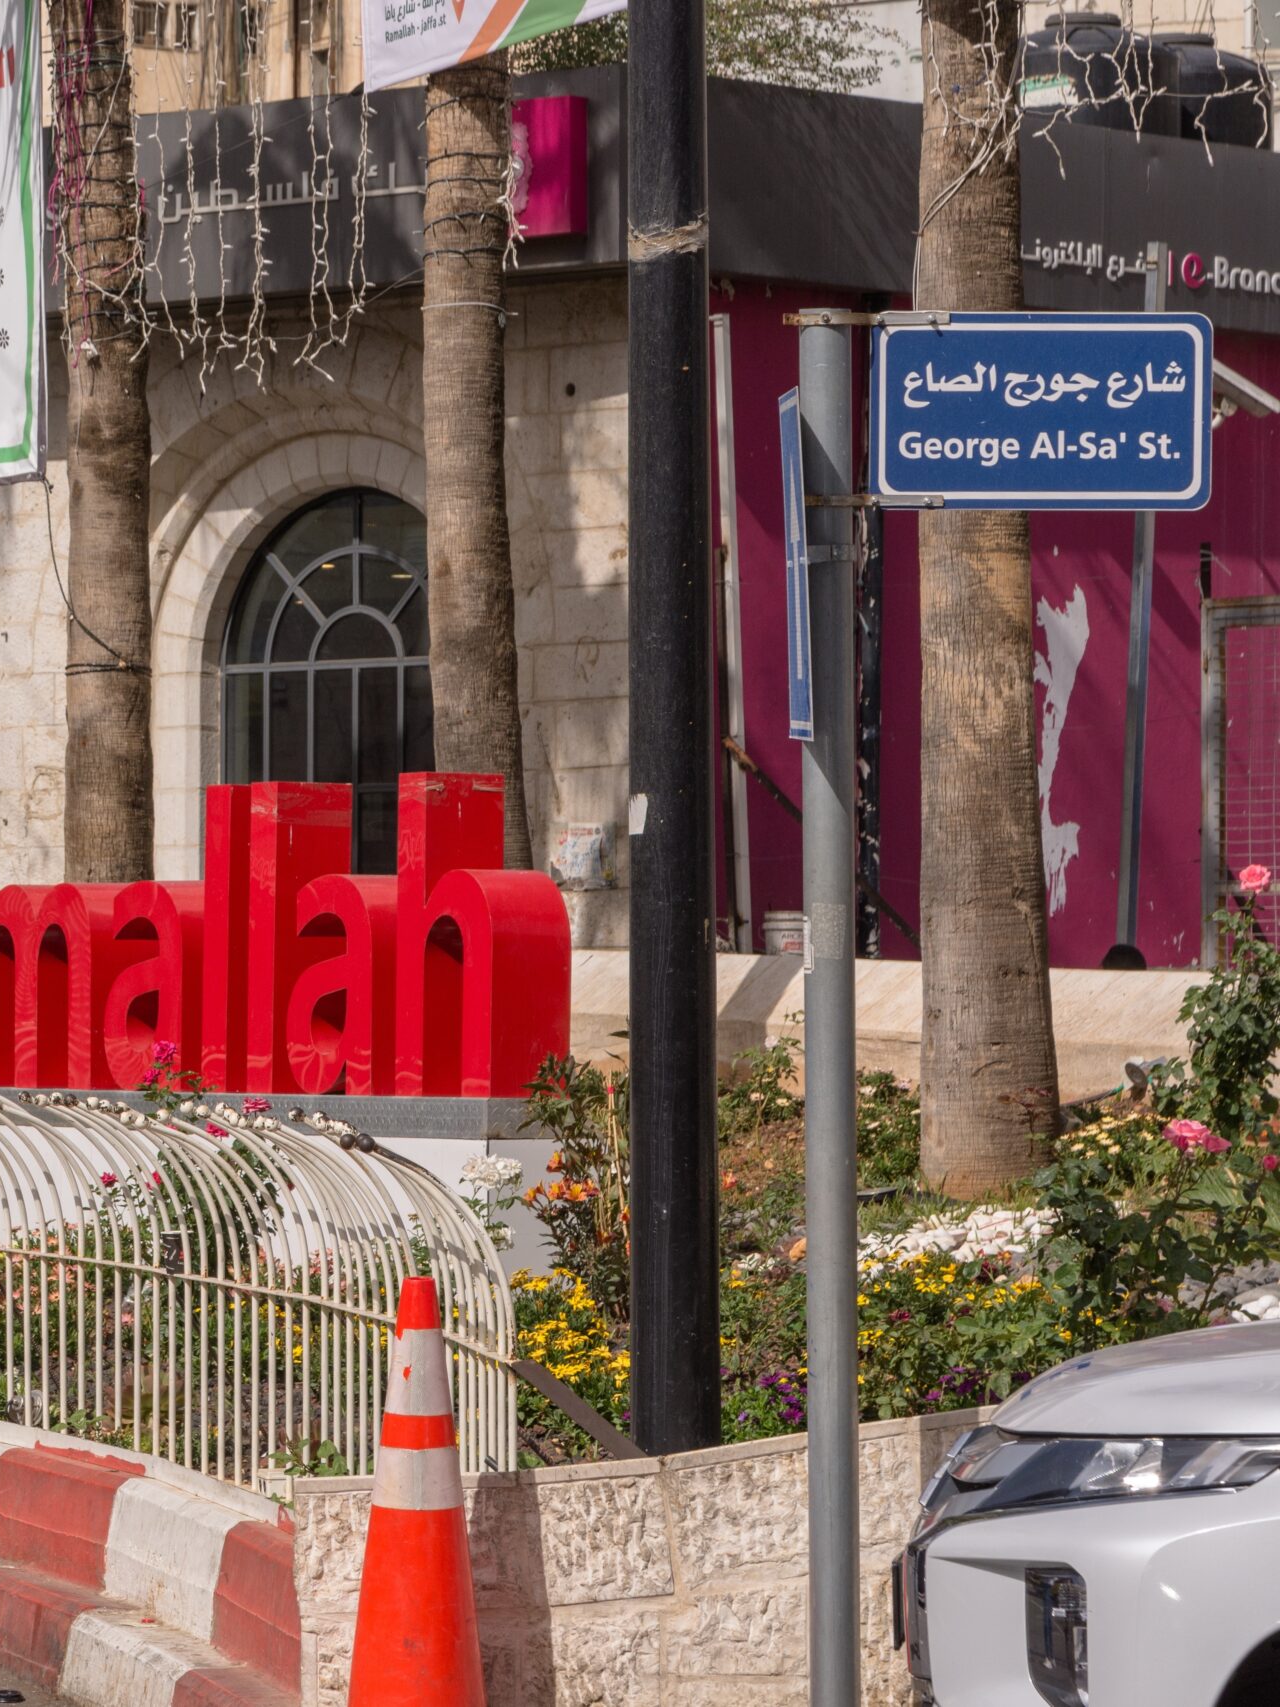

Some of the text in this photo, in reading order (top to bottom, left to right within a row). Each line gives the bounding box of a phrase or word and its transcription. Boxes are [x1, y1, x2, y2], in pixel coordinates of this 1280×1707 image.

[385, 22, 416, 43] Ramallah
[420, 16, 437, 36] jaffa
[157, 169, 341, 225] فلسطين
[1021, 238, 1103, 275] الإلكترون
[903, 360, 1186, 408] شارع جورج الصاع
[898, 430, 1181, 467] George Al-Sa' St.
